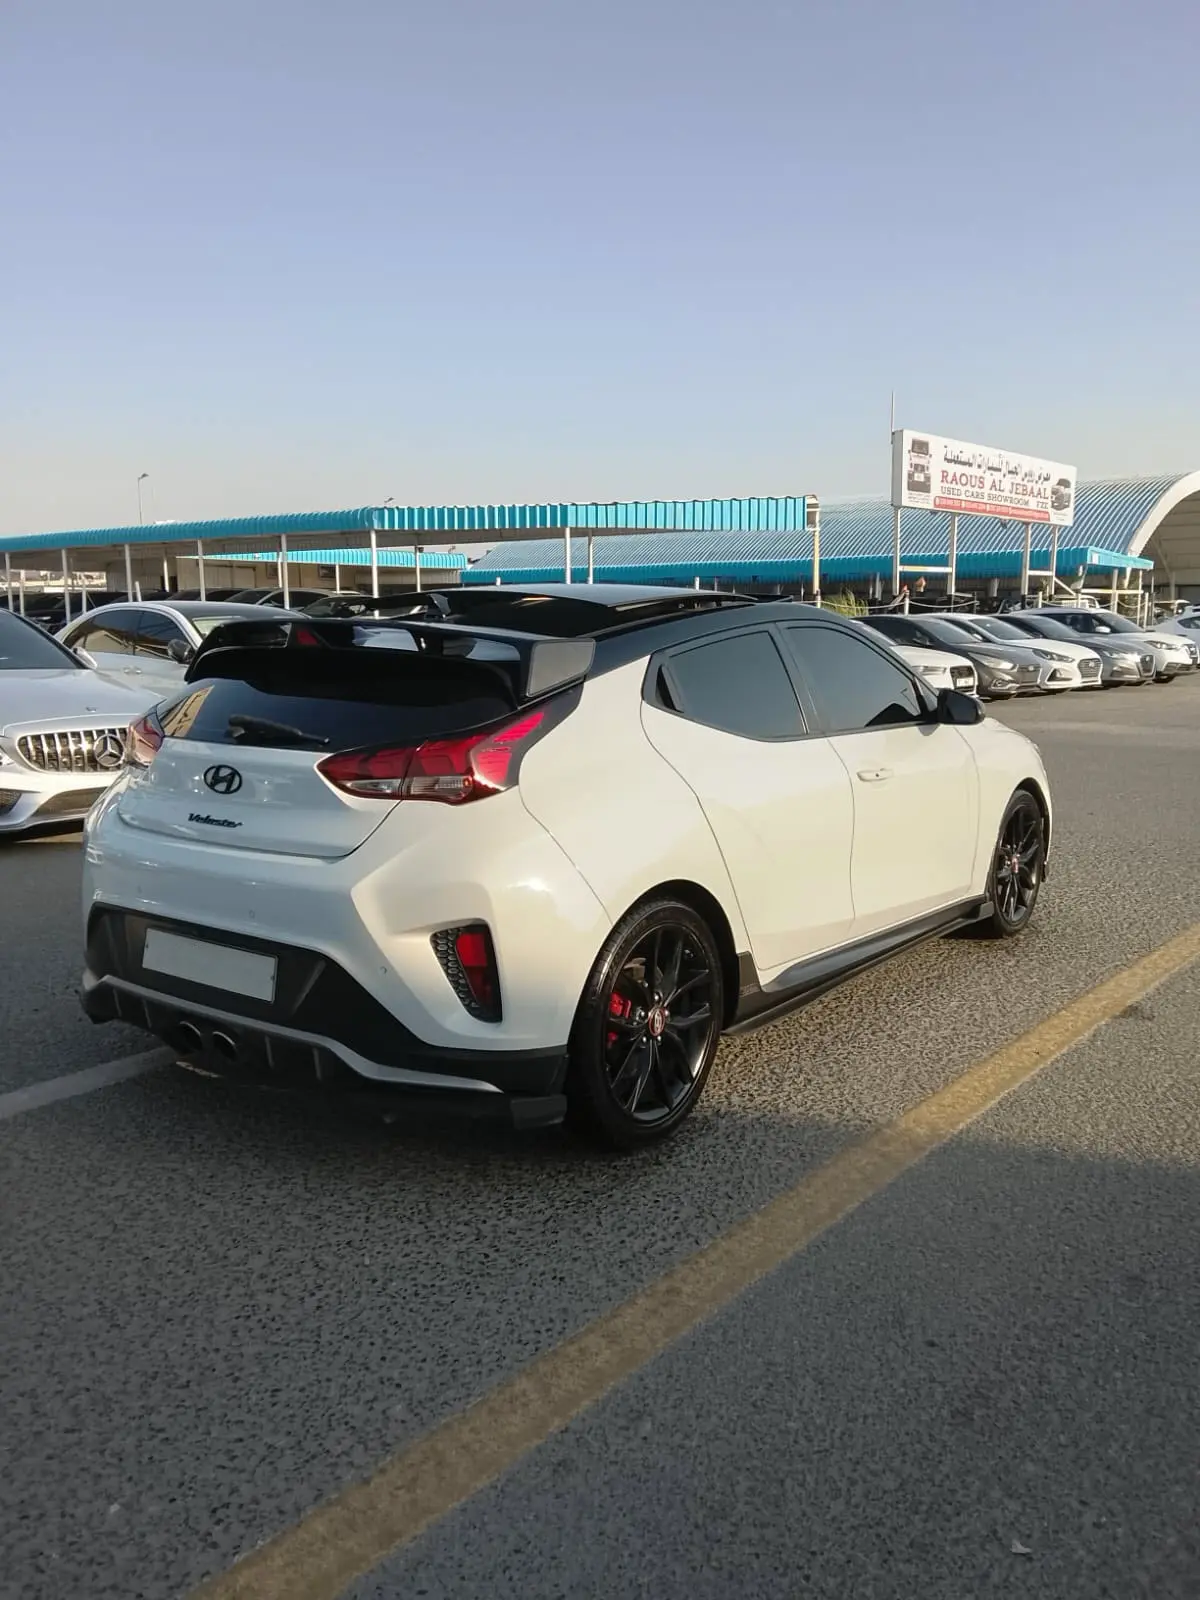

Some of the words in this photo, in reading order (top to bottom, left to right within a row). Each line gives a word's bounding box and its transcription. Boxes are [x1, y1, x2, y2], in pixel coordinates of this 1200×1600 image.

[940, 470, 985, 489] RAOUS
[989, 479, 1005, 492] AL
[1009, 482, 1049, 499] JEBAAL
[940, 486, 961, 496] USED
[964, 489, 985, 500] CARS
[987, 493, 1030, 506] SHOWROOM
[188, 812, 243, 828] Veloster
